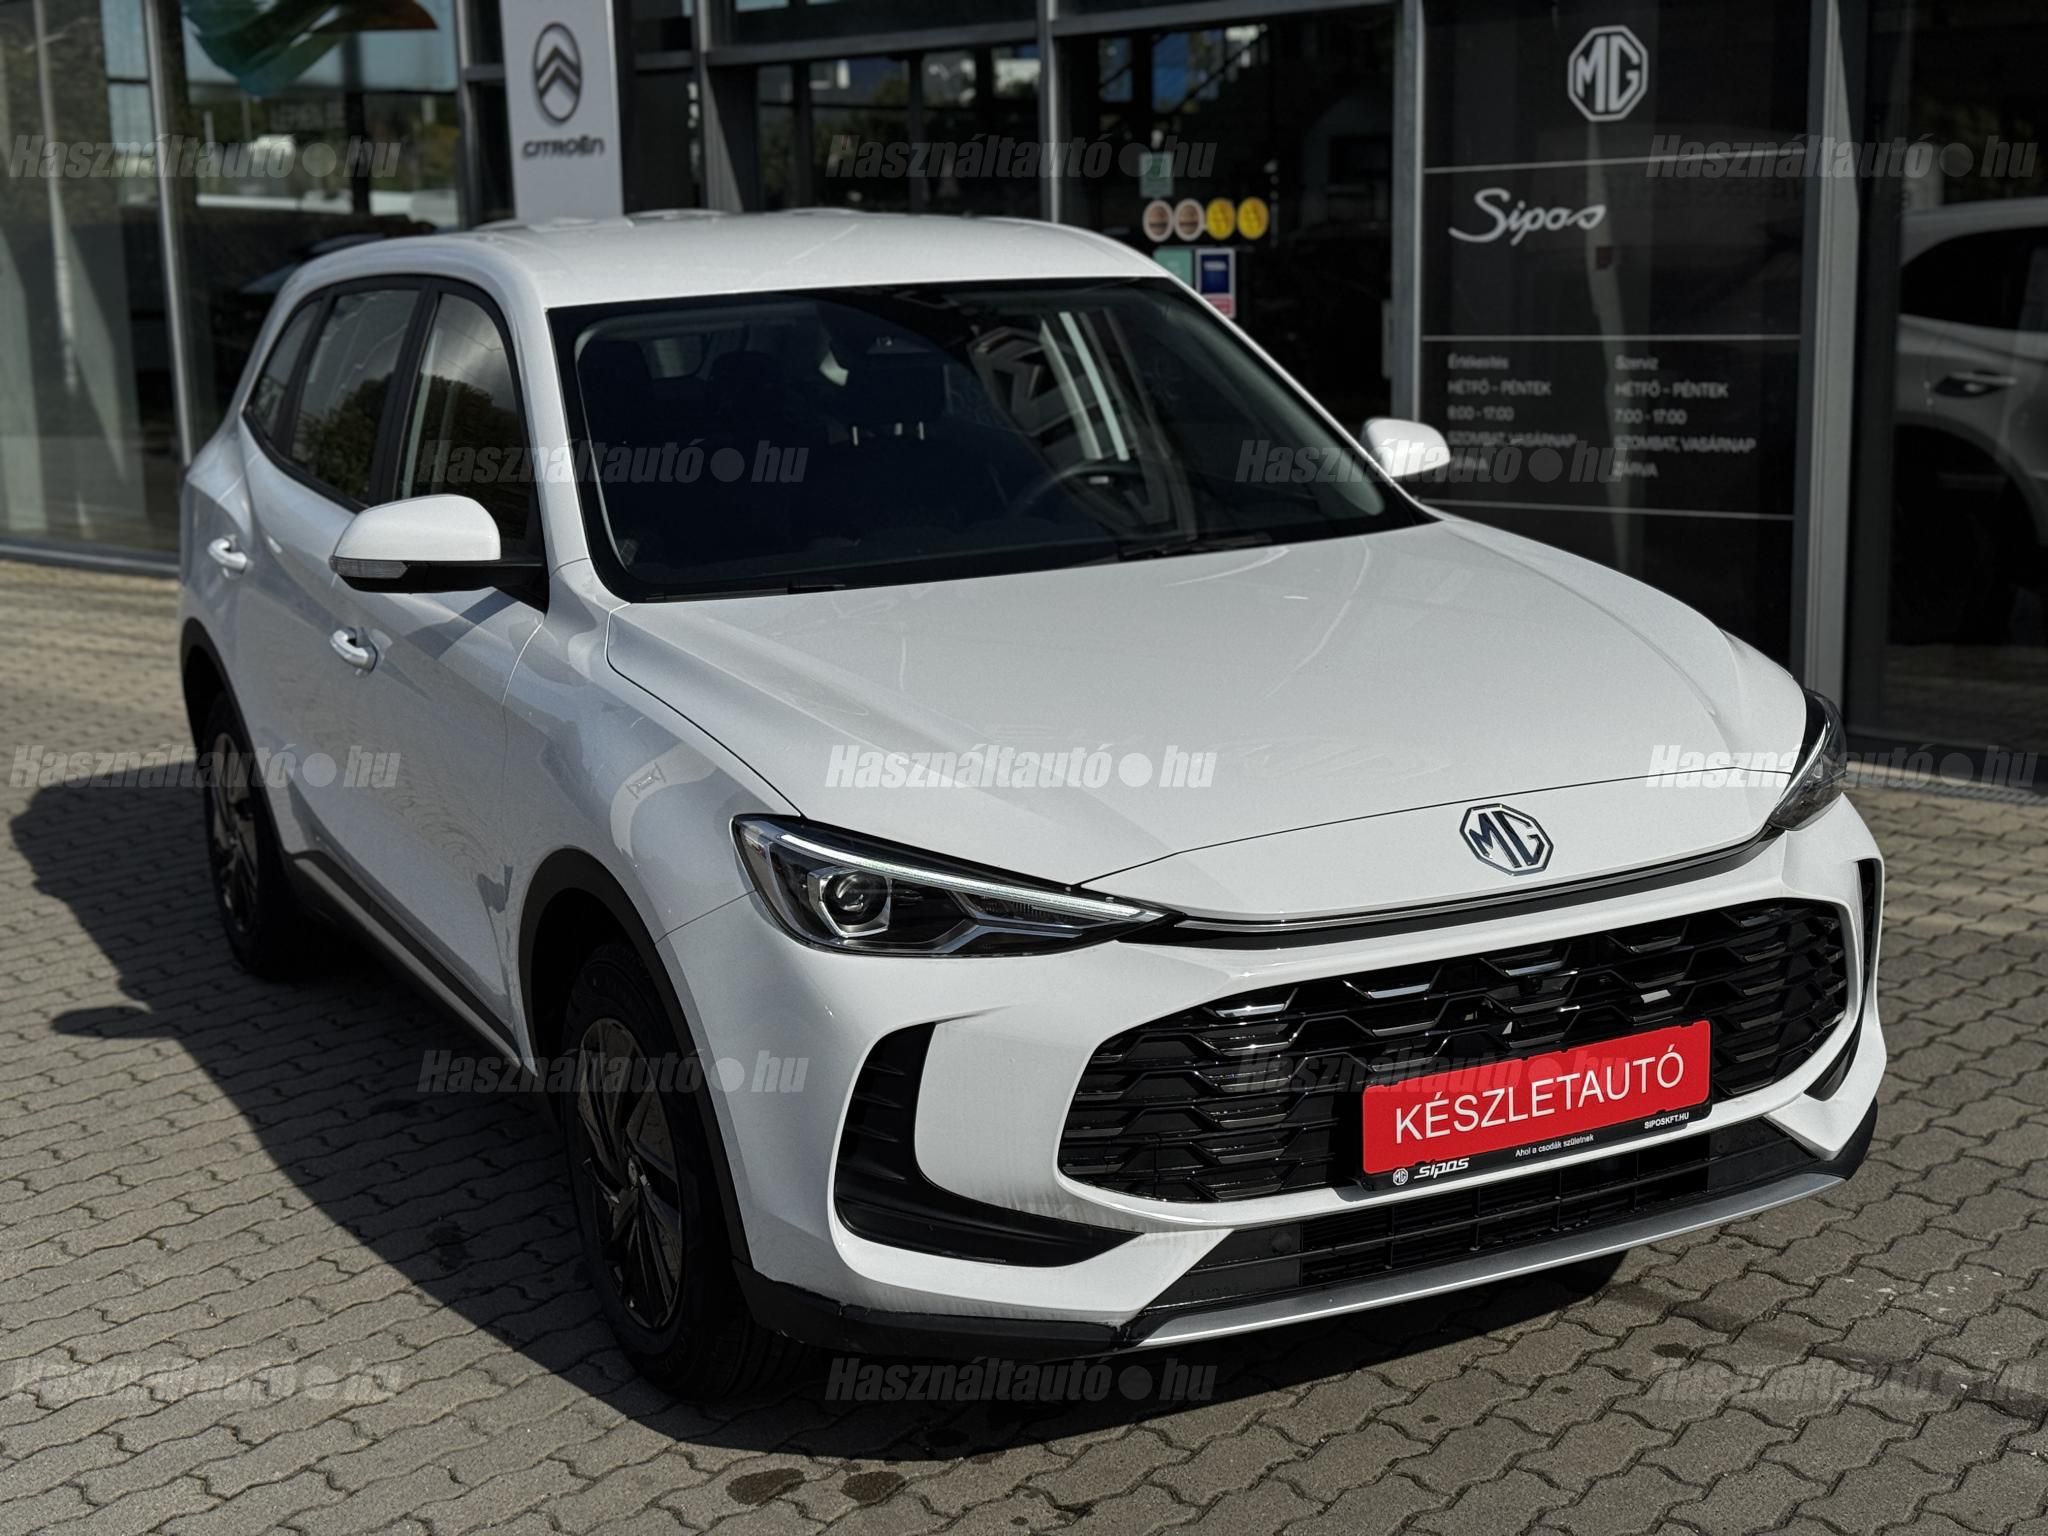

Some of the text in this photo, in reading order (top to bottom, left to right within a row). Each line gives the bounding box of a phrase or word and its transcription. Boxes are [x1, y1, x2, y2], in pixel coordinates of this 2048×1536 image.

[1572, 32, 1642, 115] MG
[1448, 188, 1607, 246] Sipos
[1500, 378, 1552, 395] PÉNTEK
[1614, 379, 1660, 398] HÉTFŐ
[1672, 378, 1729, 398] PÉNTEK
[1681, 434, 1757, 453] VASÁRNAP
[1466, 808, 1547, 870] MG
[1395, 1044, 1685, 1144] KÉSZLETAUTÓ
[1644, 1112, 1690, 1130] SIPOSKFT.HU
[1515, 1145, 1531, 1158] Ahol
[1538, 1140, 1562, 1155] csodák
[1563, 1133, 1594, 1148] születnek
[1393, 1168, 1409, 1185] MG
